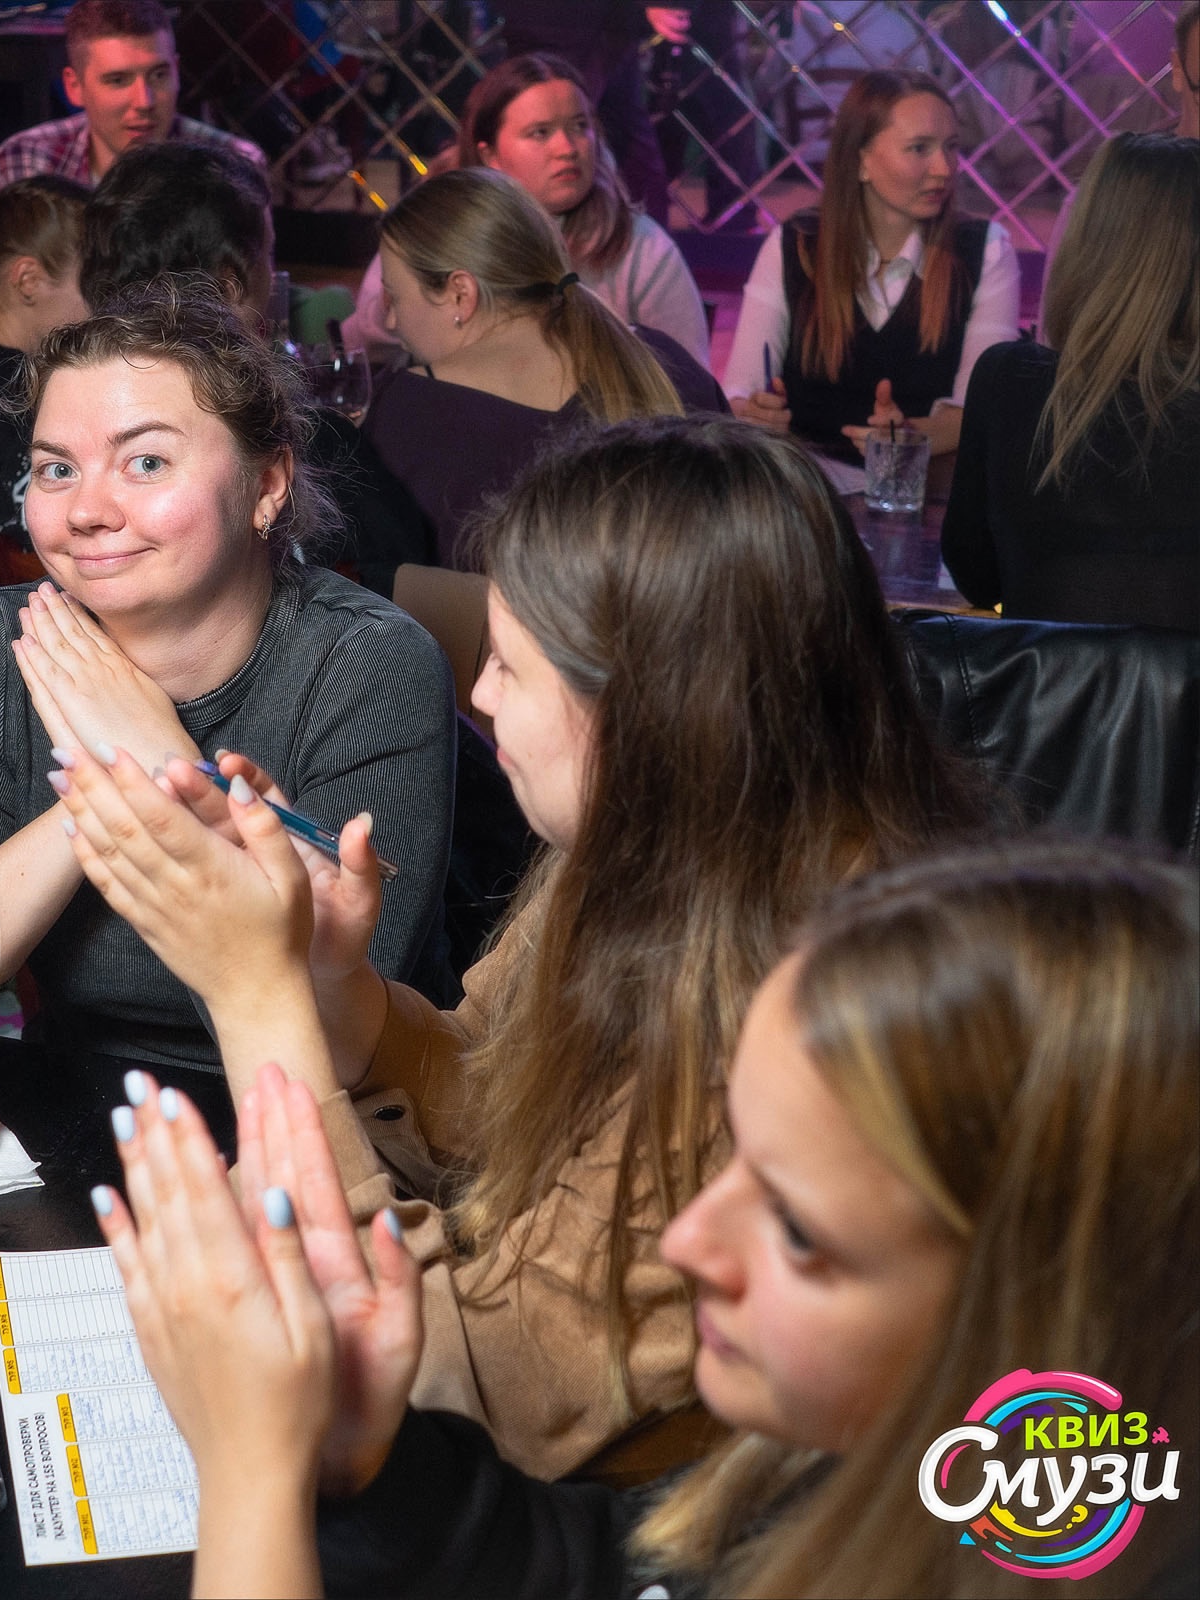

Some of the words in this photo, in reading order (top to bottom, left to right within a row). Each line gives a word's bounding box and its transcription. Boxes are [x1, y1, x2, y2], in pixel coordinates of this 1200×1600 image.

[18, 1417, 40, 1489] САМОПРОВЕРКИ
[34, 1411, 52, 1463] ВОПРОСОВ)
[43, 1464, 55, 1479] 155
[30, 1491, 44, 1509] ДЛЯ
[32, 1513, 48, 1539] ЛИСТ
[48, 1496, 66, 1541] (КАУНТЕР
